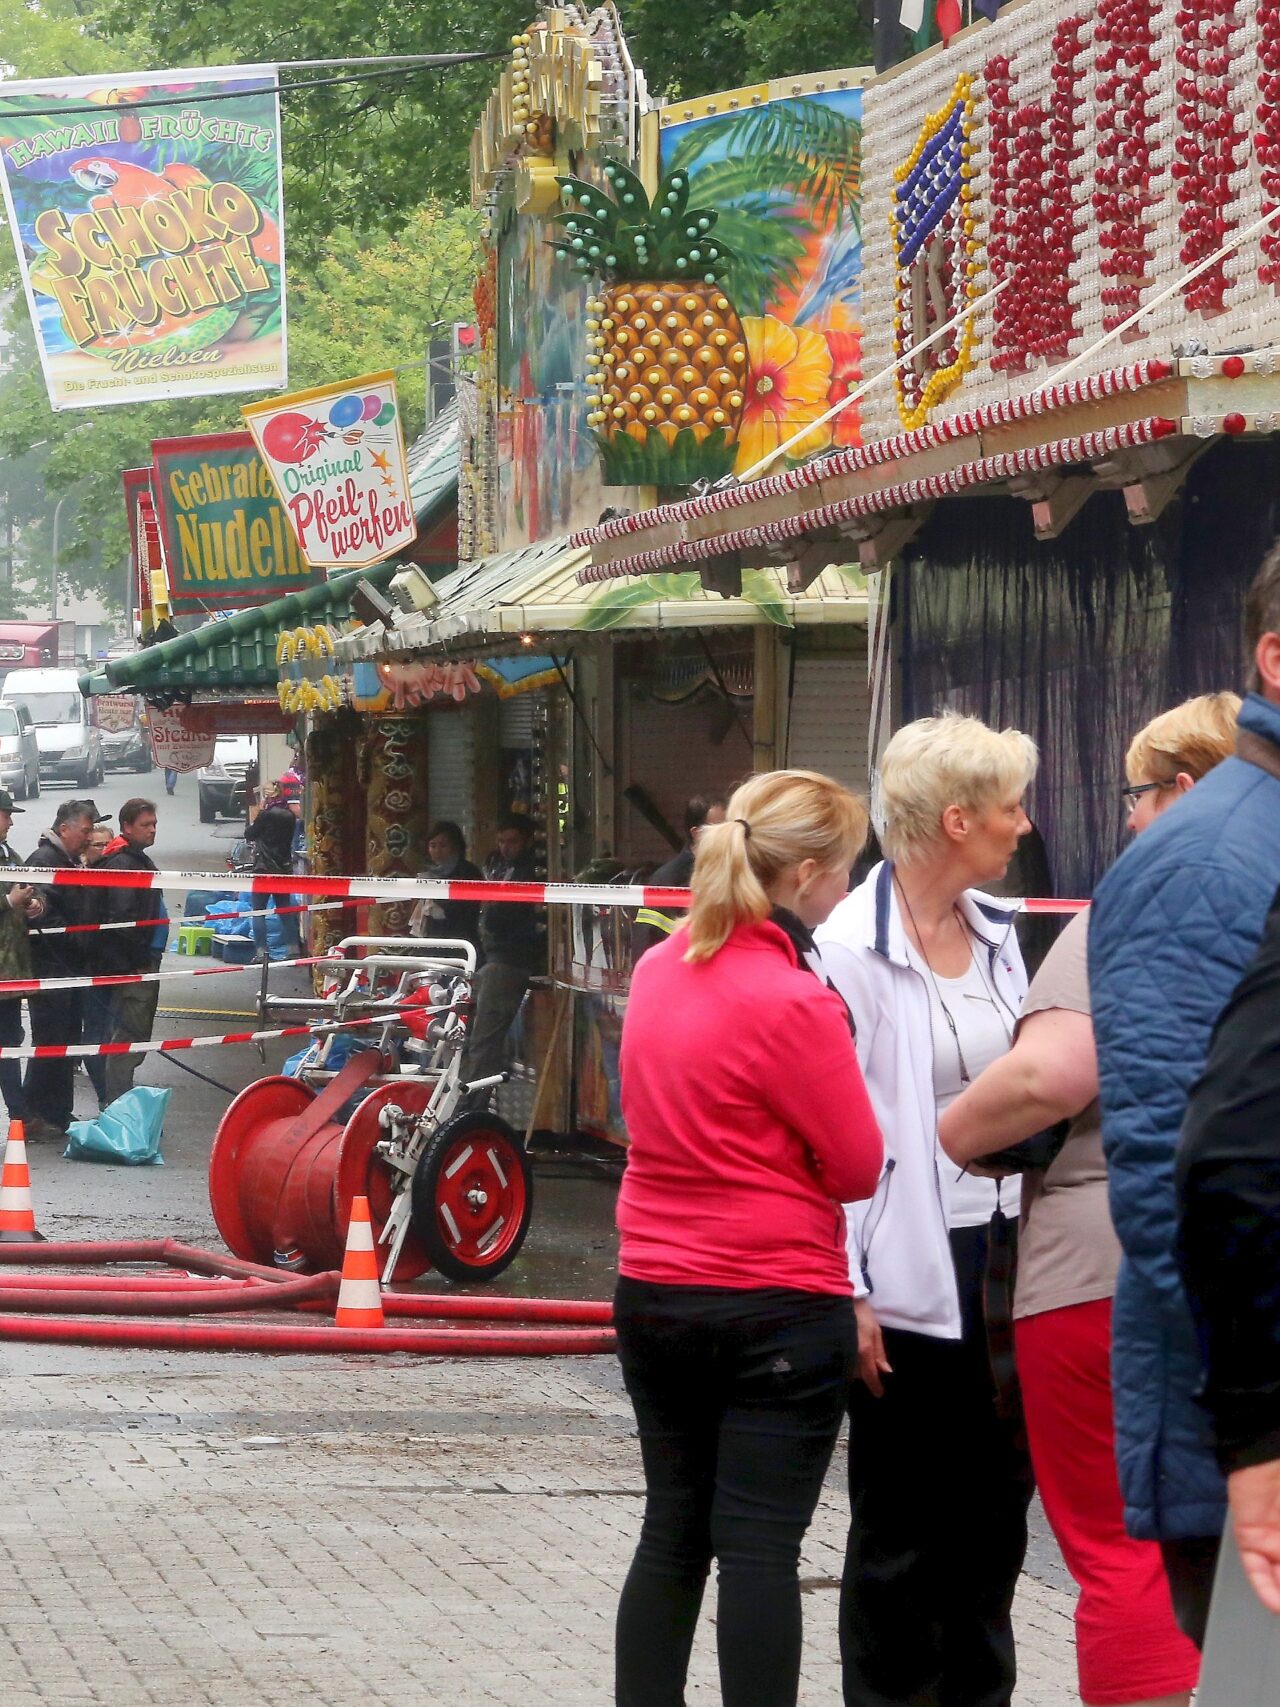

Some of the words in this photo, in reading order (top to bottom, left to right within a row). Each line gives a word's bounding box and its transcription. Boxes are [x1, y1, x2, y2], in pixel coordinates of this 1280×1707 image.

[8, 119, 120, 167] HAWAII
[140, 110, 274, 151] FRÜCHTE
[35, 182, 261, 278] SCHOKO
[50, 236, 271, 346] FRÜCHTE
[64, 380, 85, 392] Die
[87, 378, 131, 390] Frucht-
[133, 374, 157, 385] und
[161, 362, 279, 383] Schokospezialisten
[107, 346, 224, 373] Nielsen
[170, 457, 282, 511] Gebrate
[283, 450, 364, 494] Original
[288, 477, 365, 550] Pfeil-
[331, 488, 412, 559] werfen
